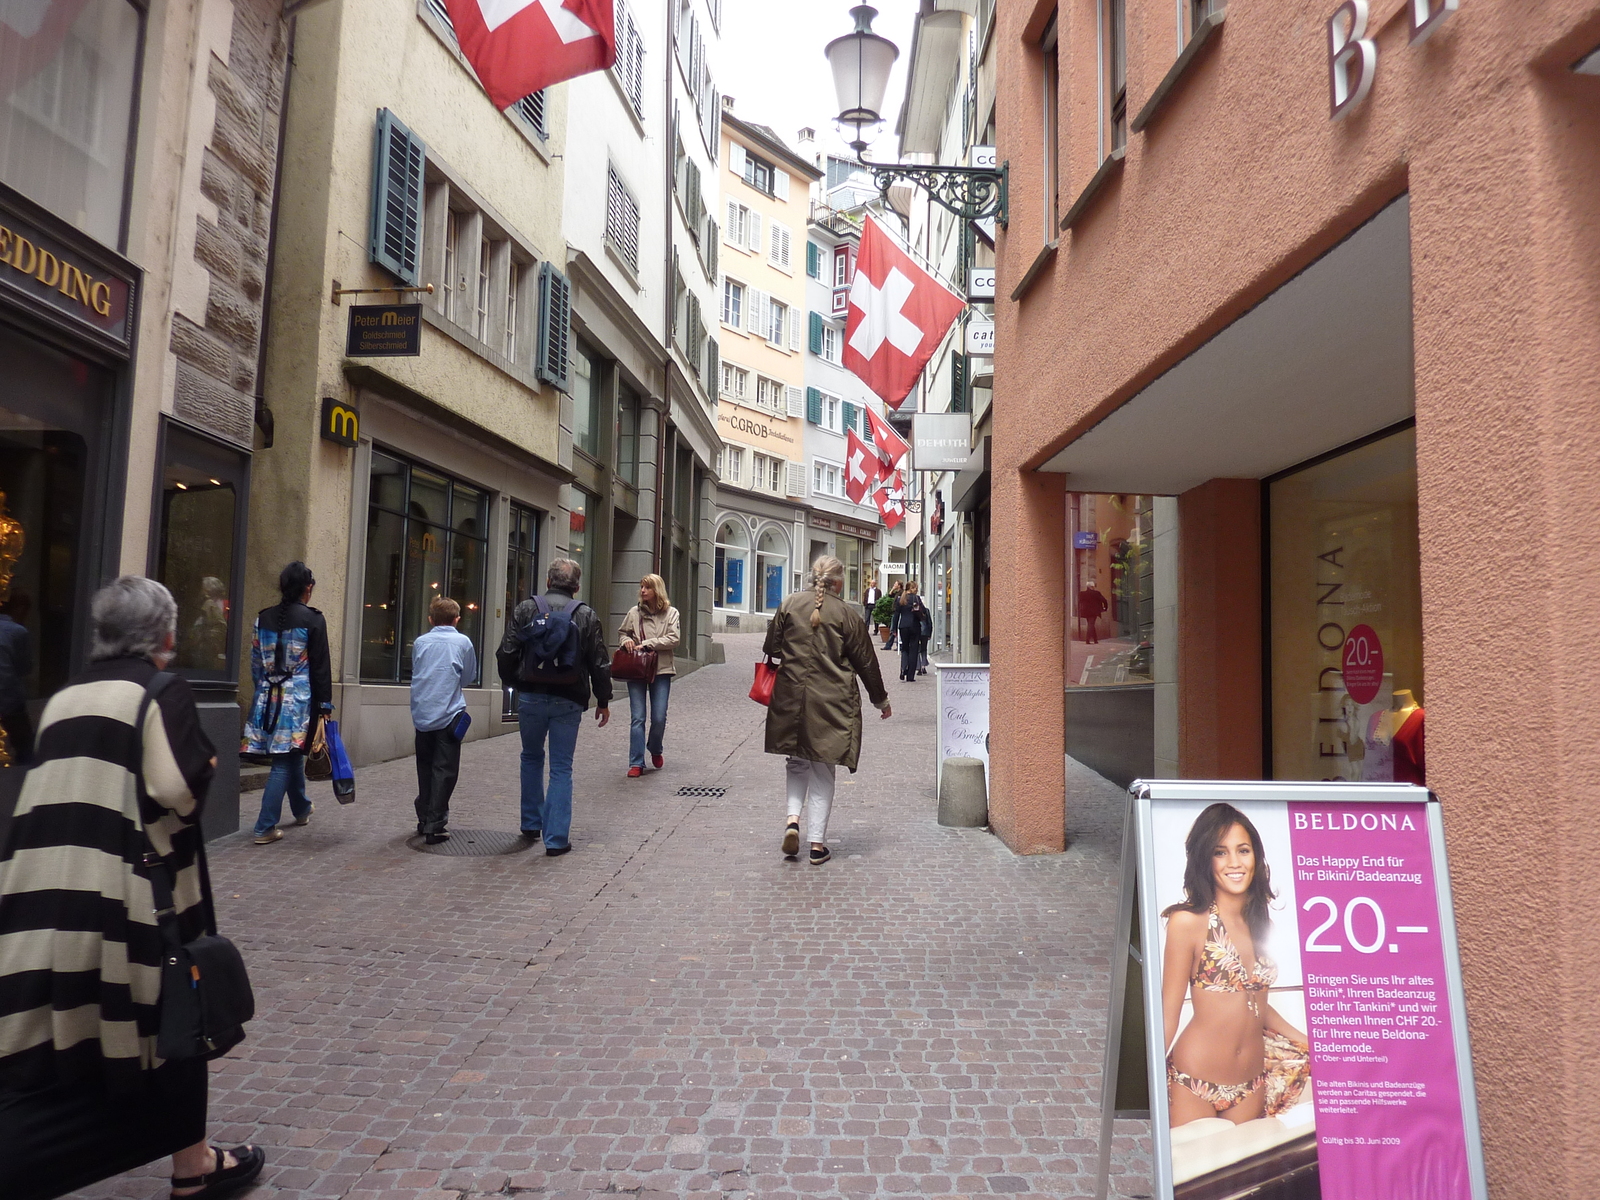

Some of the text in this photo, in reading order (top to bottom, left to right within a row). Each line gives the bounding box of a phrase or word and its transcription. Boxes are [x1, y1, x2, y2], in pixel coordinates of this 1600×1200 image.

[354, 315, 379, 327] Peter
[362, 330, 406, 339] Goldschmied
[359, 341, 408, 350] Silberschmied
[730, 415, 768, 438] C.GROB
[917, 438, 967, 447] DEMUTH
[946, 686, 986, 700] Highlights
[944, 706, 966, 720] Cut
[952, 727, 984, 740] Brush
[1294, 812, 1416, 831] BELDONA
[1297, 855, 1405, 869] Das Happy End für
[1298, 870, 1422, 885] Ihr Bikini/Badeanzug
[1307, 973, 1434, 987] Bringen Sie uns Ihr altes
[1347, 987, 1374, 998] Ihren
[1376, 988, 1436, 1001] Badeanzug
[1309, 1001, 1334, 1011] oder
[1337, 1001, 1351, 1011] Ihr
[1398, 1002, 1419, 1012] und
[1420, 1002, 1437, 1012] wir
[1311, 1014, 1361, 1025] schenken
[1364, 1015, 1394, 1025] Ihnen
[1395, 1015, 1418, 1026] CHF
[1312, 1028, 1429, 1040] für Ihre neue Beldona-
[1313, 1041, 1375, 1053] Bademode.
[1357, 1055, 1388, 1063] Unterteil)
[1384, 1081, 1426, 1090] Badeanzüge
[1339, 1098, 1371, 1106] passende
[1372, 1098, 1407, 1106] Hilfswerke
[1321, 1136, 1344, 1145] Gültig
[1367, 1137, 1381, 1145] Juni
[1382, 1137, 1400, 1145] 2009
